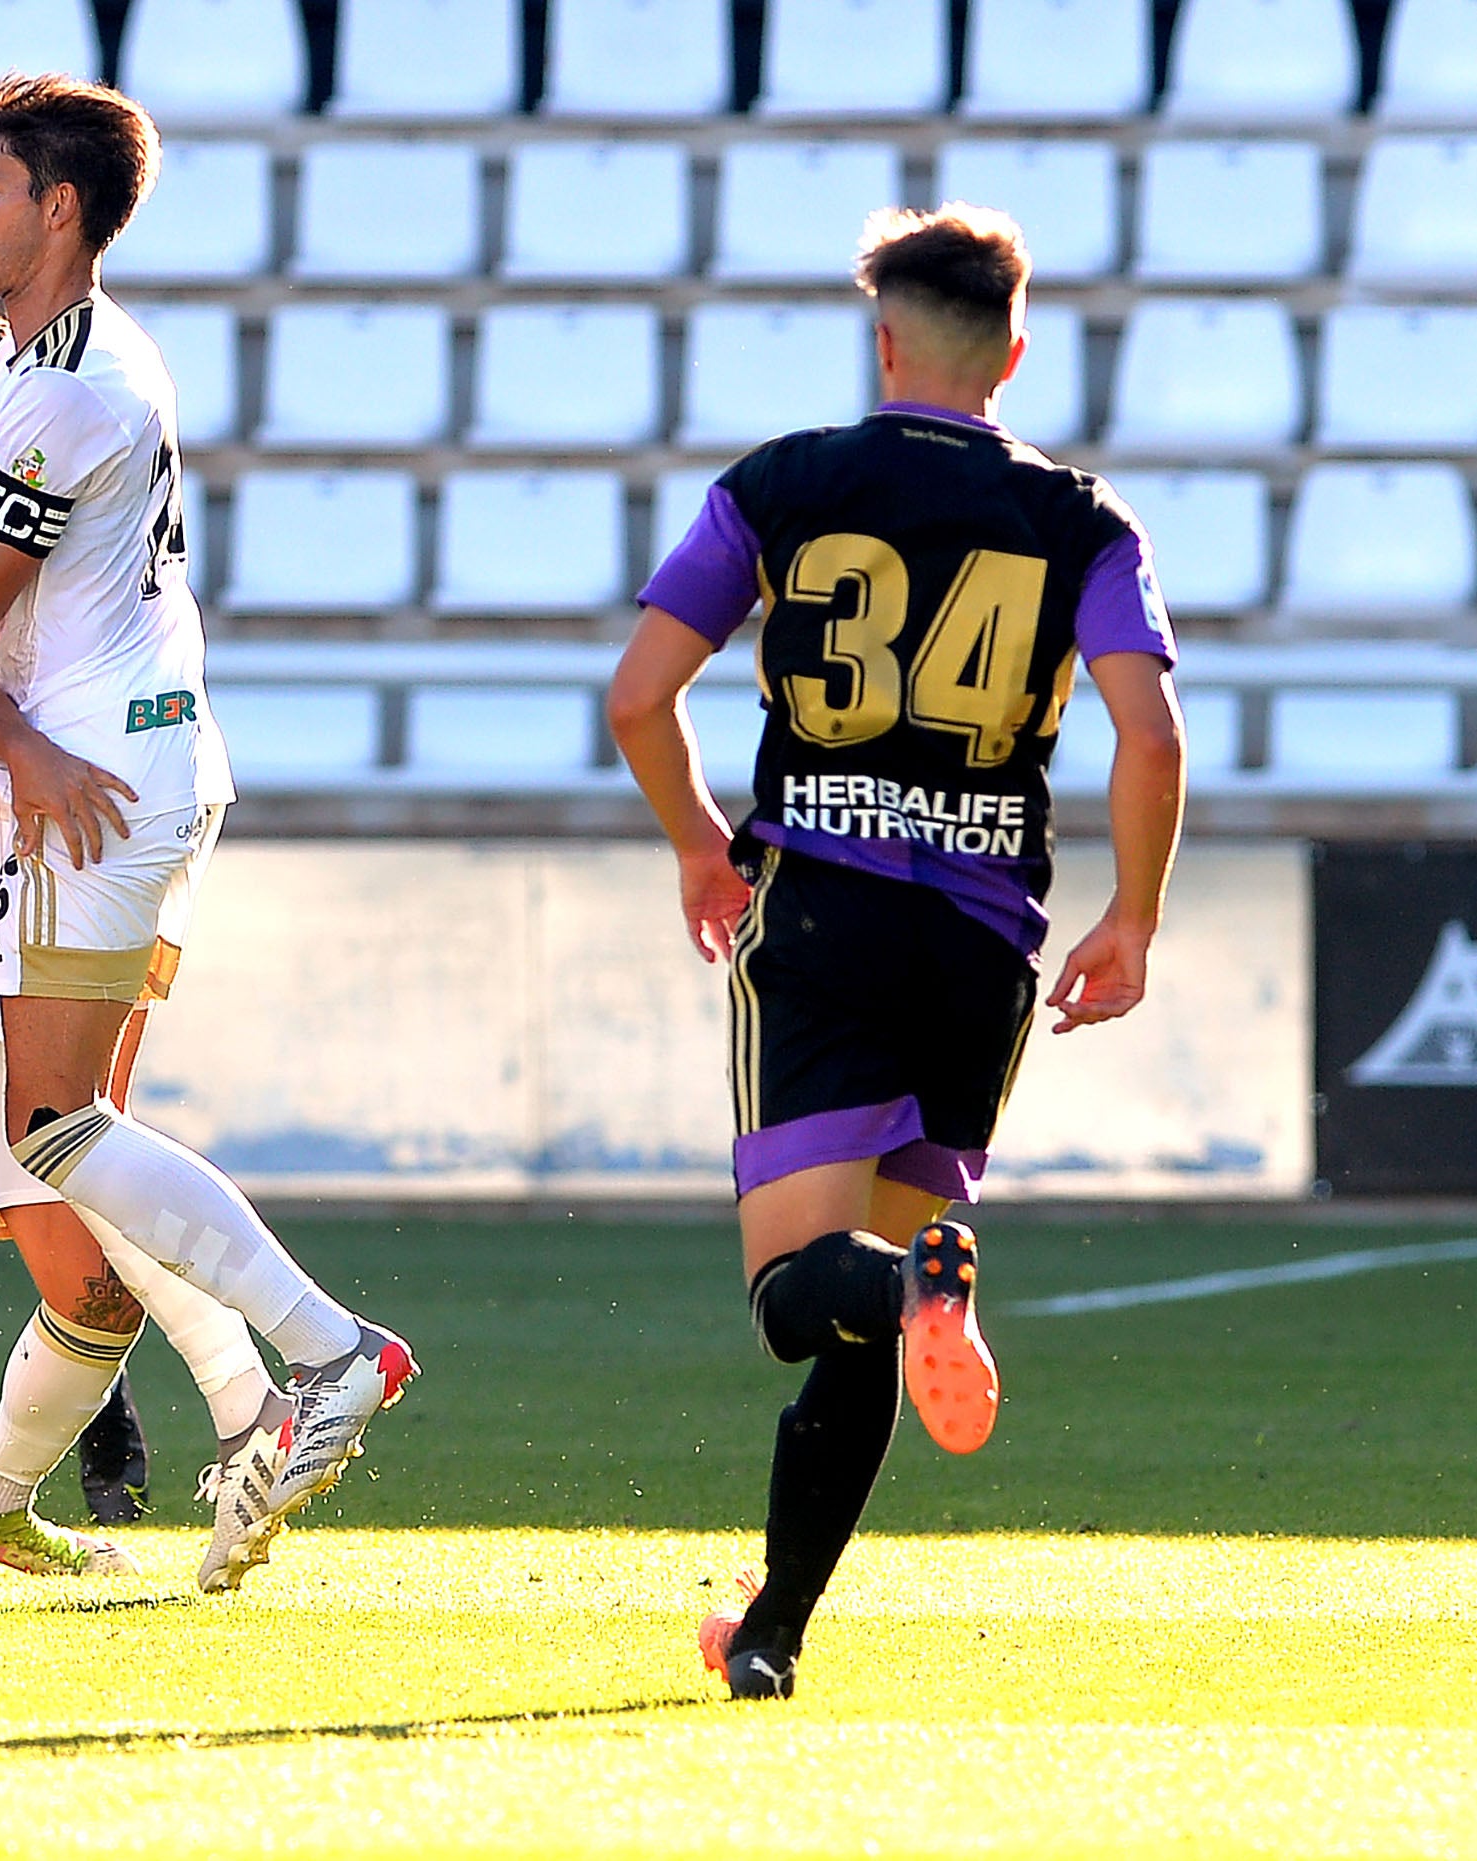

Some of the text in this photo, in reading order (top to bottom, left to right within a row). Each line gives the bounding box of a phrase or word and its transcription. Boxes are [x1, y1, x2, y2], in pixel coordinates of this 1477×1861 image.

[781, 533, 1049, 768] 34
[125, 690, 197, 734] BER
[783, 775, 1026, 826] HERBALIFE
[783, 807, 1024, 857] NUTRITION
